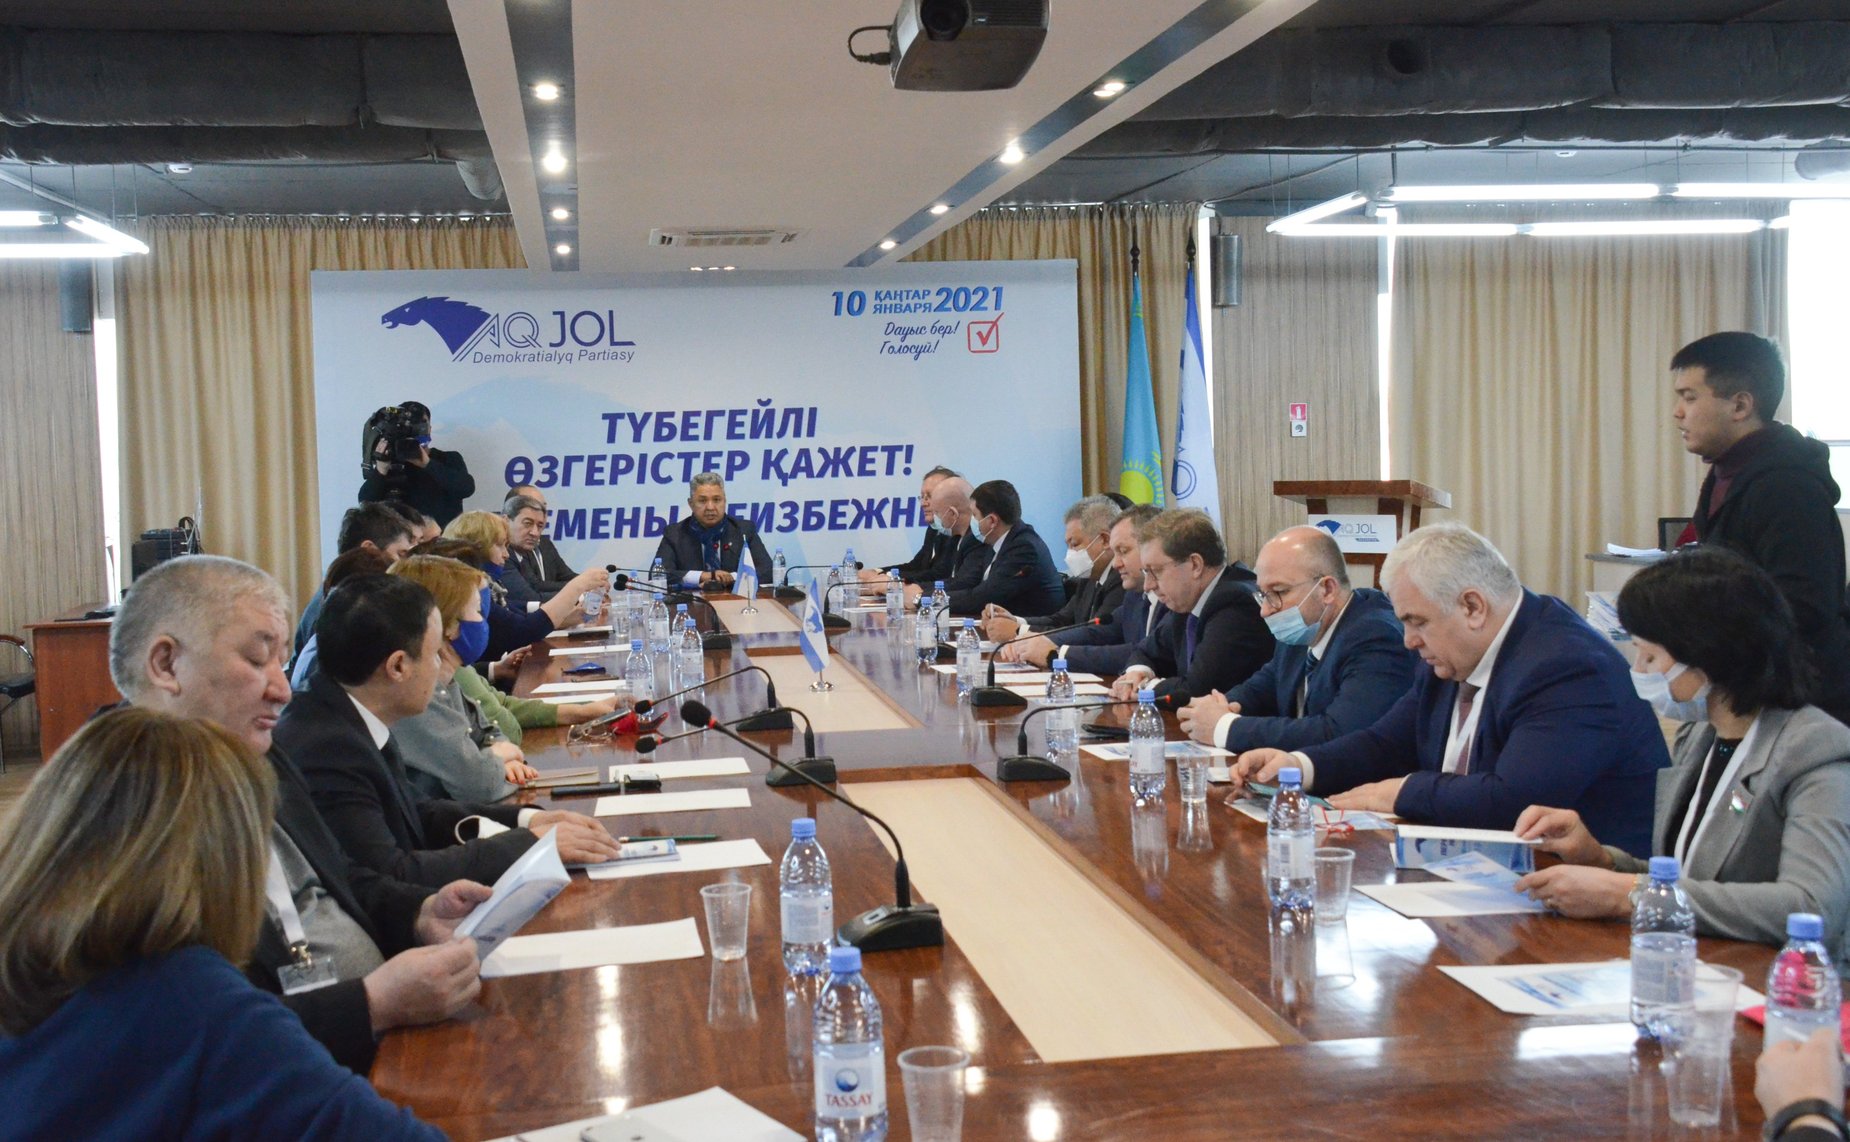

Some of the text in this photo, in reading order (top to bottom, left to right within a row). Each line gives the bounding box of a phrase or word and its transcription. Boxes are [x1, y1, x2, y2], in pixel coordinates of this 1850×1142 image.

[832, 291, 867, 317] 10
[933, 286, 1004, 313] 2021
[872, 302, 933, 315] ЯНВАРЯ
[549, 310, 636, 348] JOL
[929, 320, 961, 338] бер!
[472, 349, 635, 364] Demokratialyq Partiasy
[879, 339, 940, 361] Голосуй!
[760, 443, 914, 487] ҚАЖЕТ!
[826, 1093, 872, 1107] TASSAY
